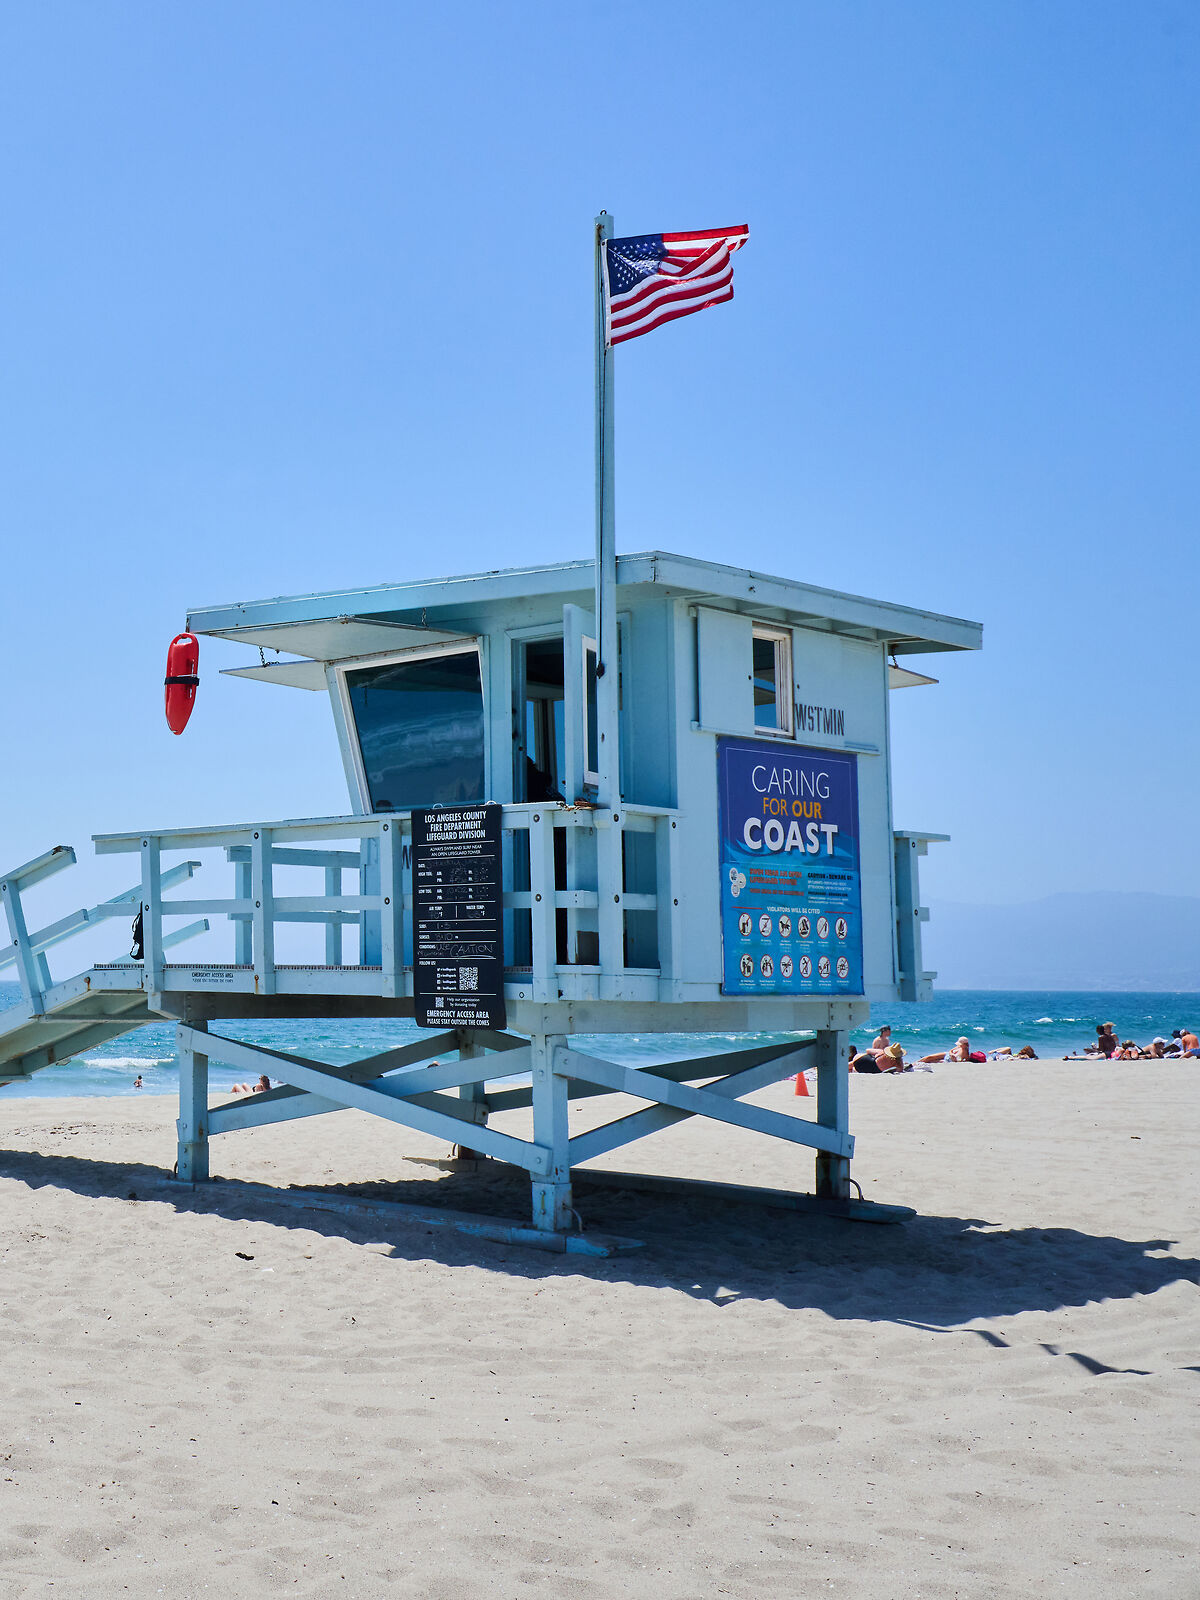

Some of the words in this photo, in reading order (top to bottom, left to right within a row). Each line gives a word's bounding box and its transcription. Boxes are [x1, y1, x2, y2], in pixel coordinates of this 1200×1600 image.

[794, 703, 845, 736] WSTMIN
[752, 765, 830, 799] CARING
[425, 815, 436, 823] LOS
[437, 812, 461, 822] ANGELES
[463, 810, 487, 820] COUNTY
[763, 797, 788, 816] FOR
[792, 800, 822, 819] OUR
[430, 823, 443, 832] FIRE
[444, 820, 481, 831] DEPARTMENT
[427, 832, 457, 841] LIFEGUARD
[459, 830, 486, 839] DIVISION
[743, 817, 838, 855] COAST
[427, 1010, 456, 1018] EMERGENCY
[456, 1010, 474, 1018] ACCESS
[475, 1011, 490, 1019] AREA
